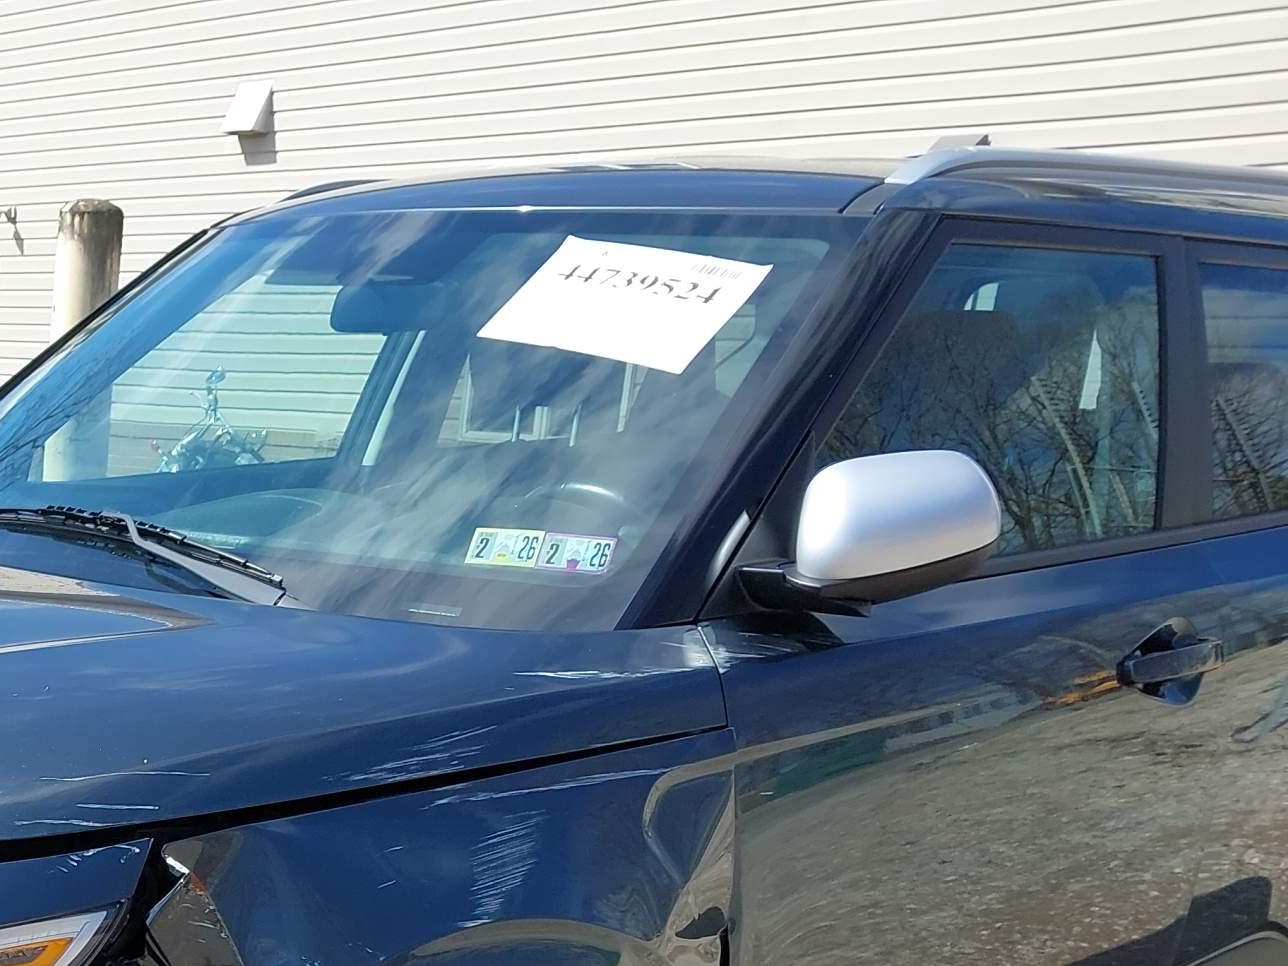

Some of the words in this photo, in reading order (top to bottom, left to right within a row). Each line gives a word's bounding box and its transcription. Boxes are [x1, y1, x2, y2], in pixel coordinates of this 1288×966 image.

[558, 263, 722, 304] 44739524
[475, 537, 490, 558] 2
[517, 535, 539, 560] 26
[546, 543, 560, 564] 2
[589, 542, 612, 568] 26
